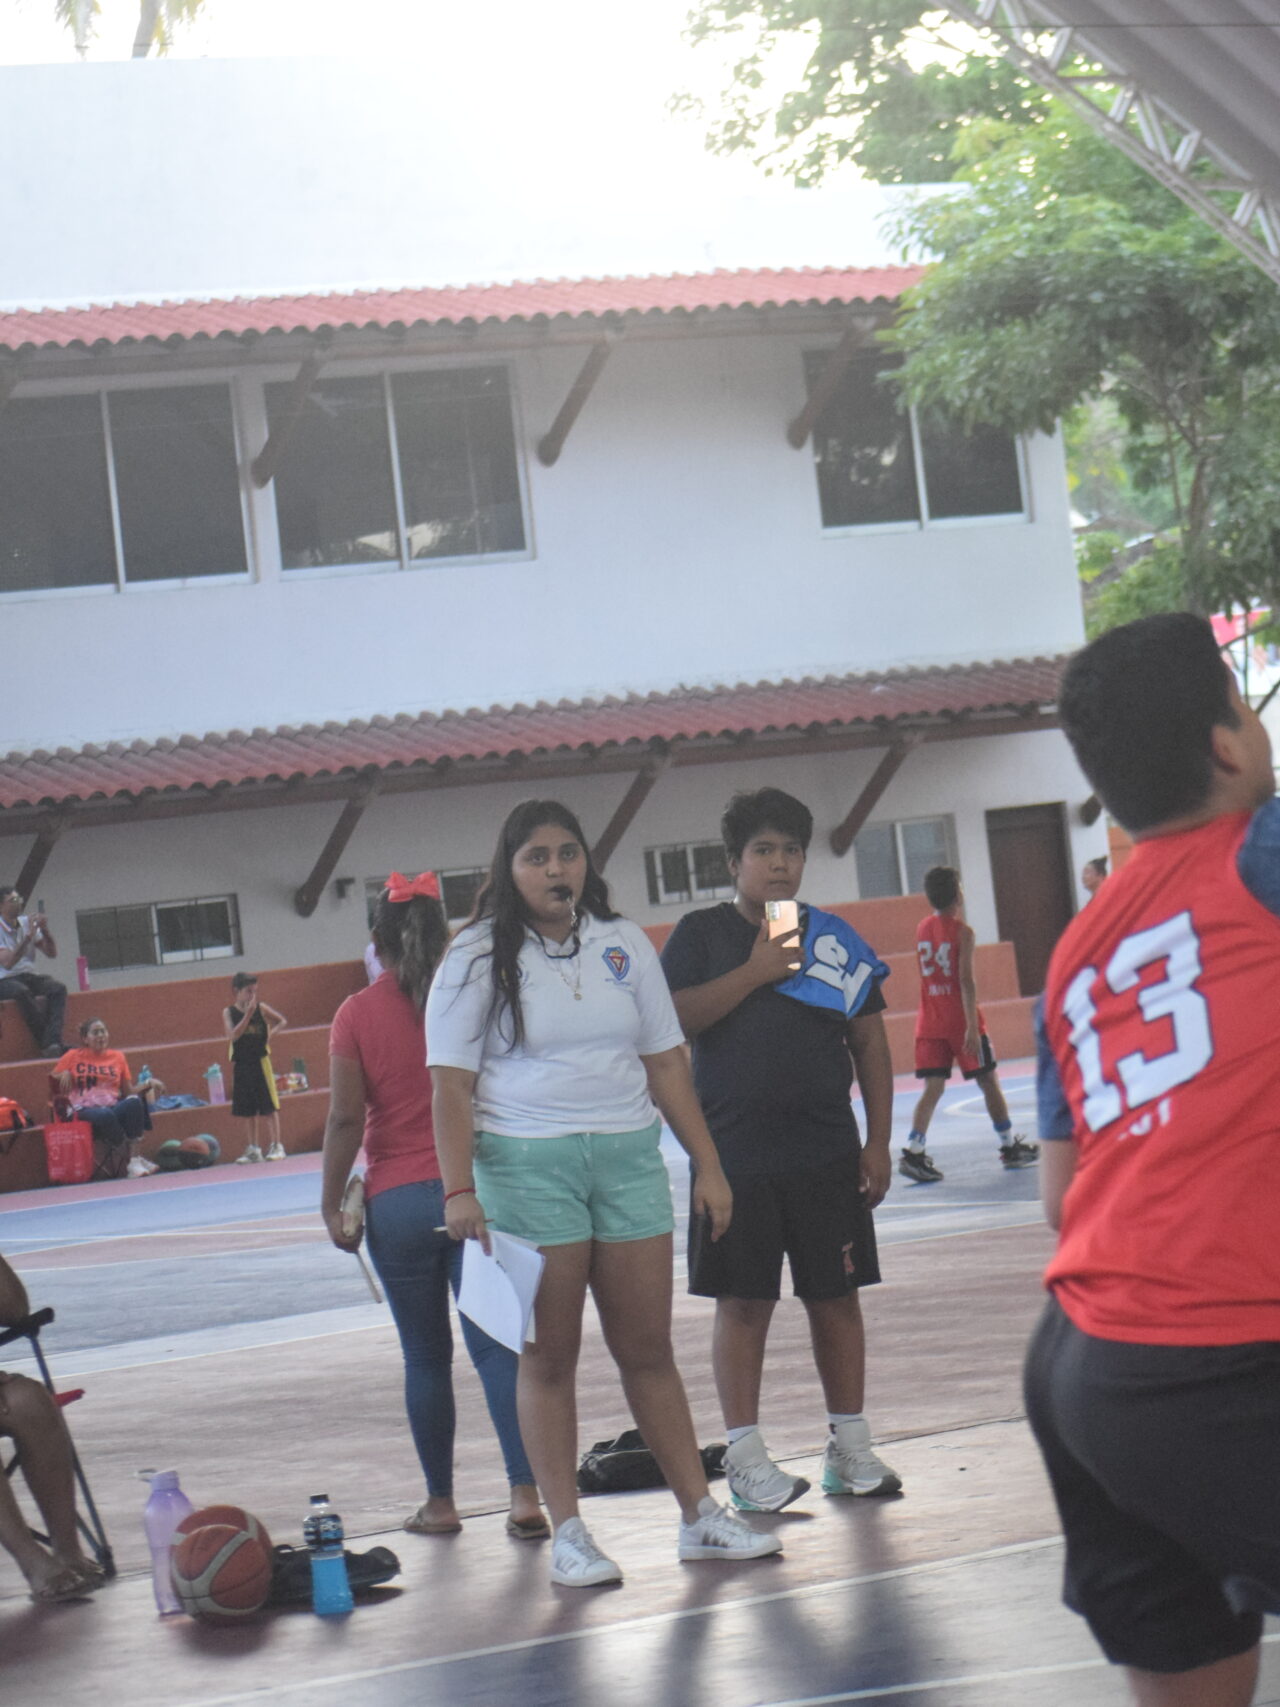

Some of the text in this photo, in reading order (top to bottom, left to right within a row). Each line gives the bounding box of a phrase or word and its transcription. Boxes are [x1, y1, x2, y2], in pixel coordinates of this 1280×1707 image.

[917, 940, 953, 978] 24
[1062, 909, 1215, 1134] 13
[75, 1062, 118, 1078] CREE
